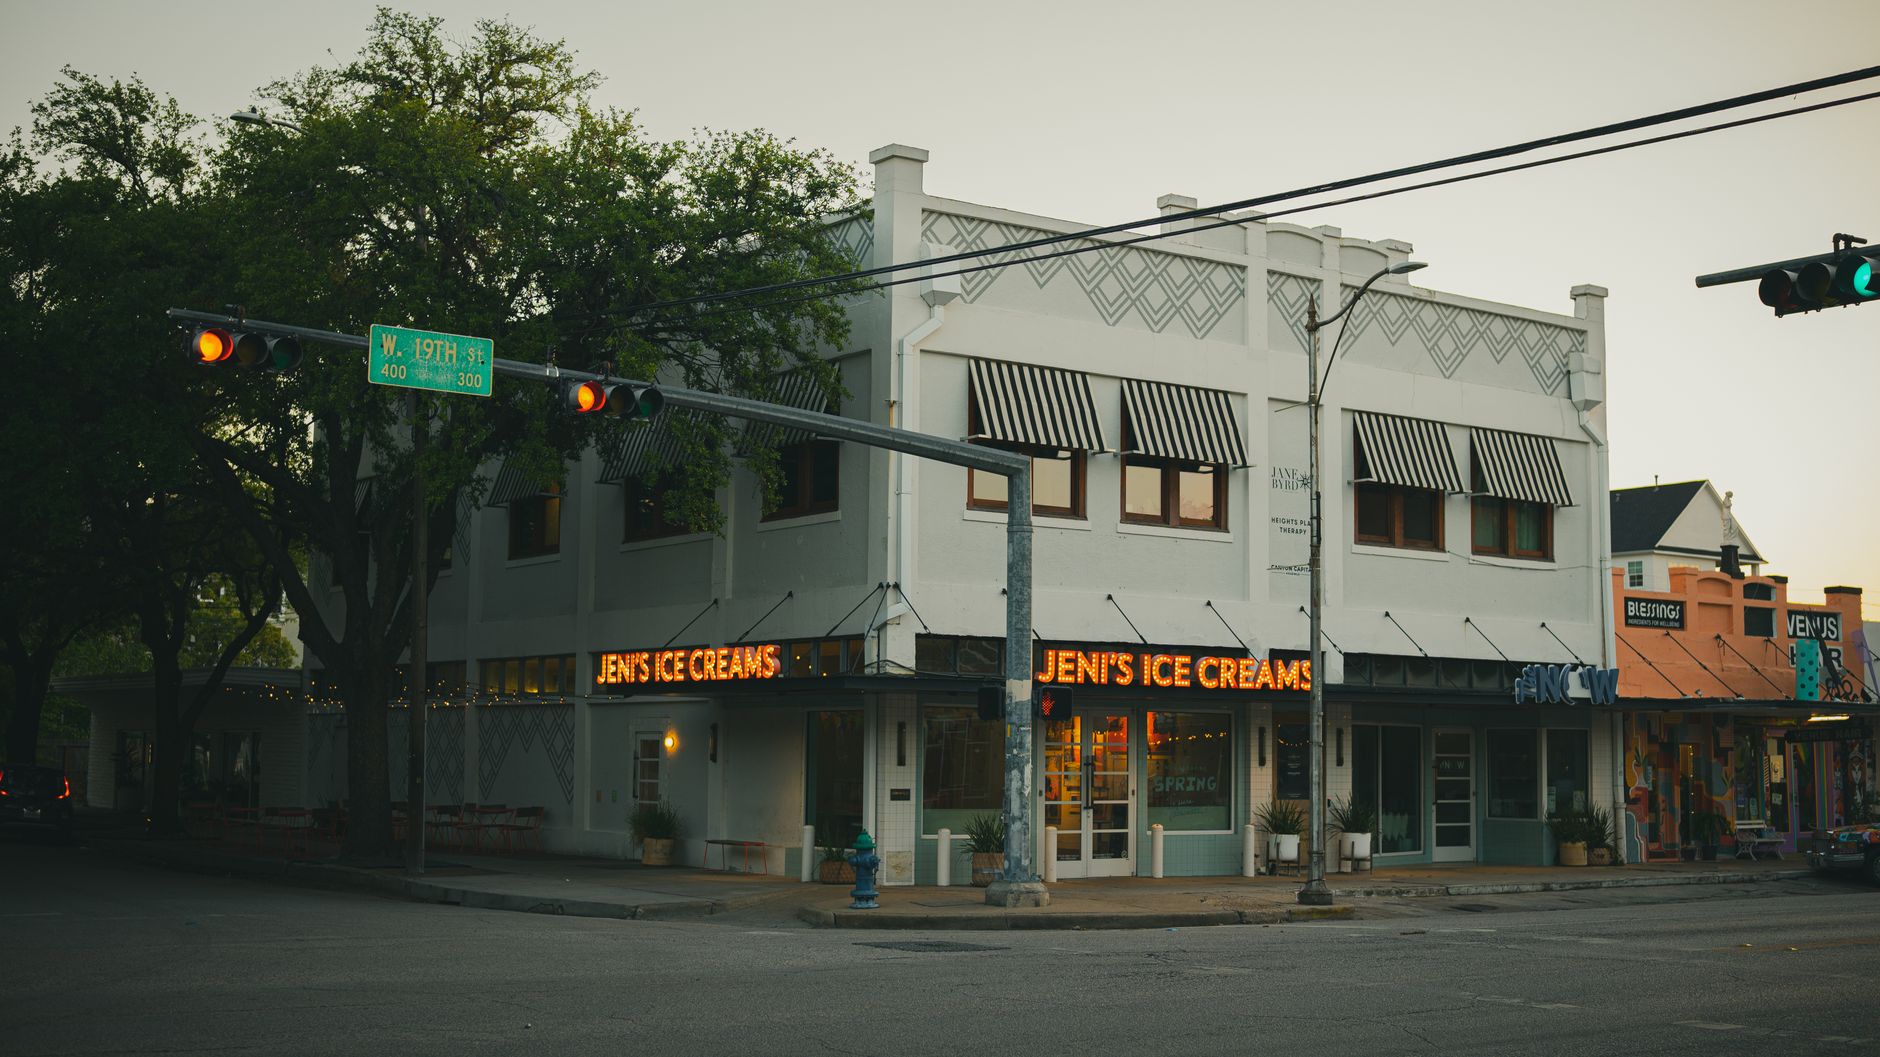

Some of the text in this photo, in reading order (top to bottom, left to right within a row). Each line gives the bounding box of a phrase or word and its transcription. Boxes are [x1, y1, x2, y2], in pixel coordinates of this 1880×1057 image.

[382, 333, 402, 357] W.
[415, 338, 457, 364] 19TH
[381, 363, 482, 388] 400 300
[1271, 466, 1299, 481] JANE
[1272, 478, 1299, 491] BYRD
[1271, 517, 1311, 527] HEIGHTS PLA
[1279, 526, 1307, 535] THERAPY
[1627, 600, 1680, 620] BLESSINGS
[1787, 614, 1838, 640] VENUS
[597, 645, 776, 684] JENI'S ICE CREAMS
[1036, 650, 1311, 691] JENI'S ICE CREAMS
[1154, 776, 1217, 793] SPRING
